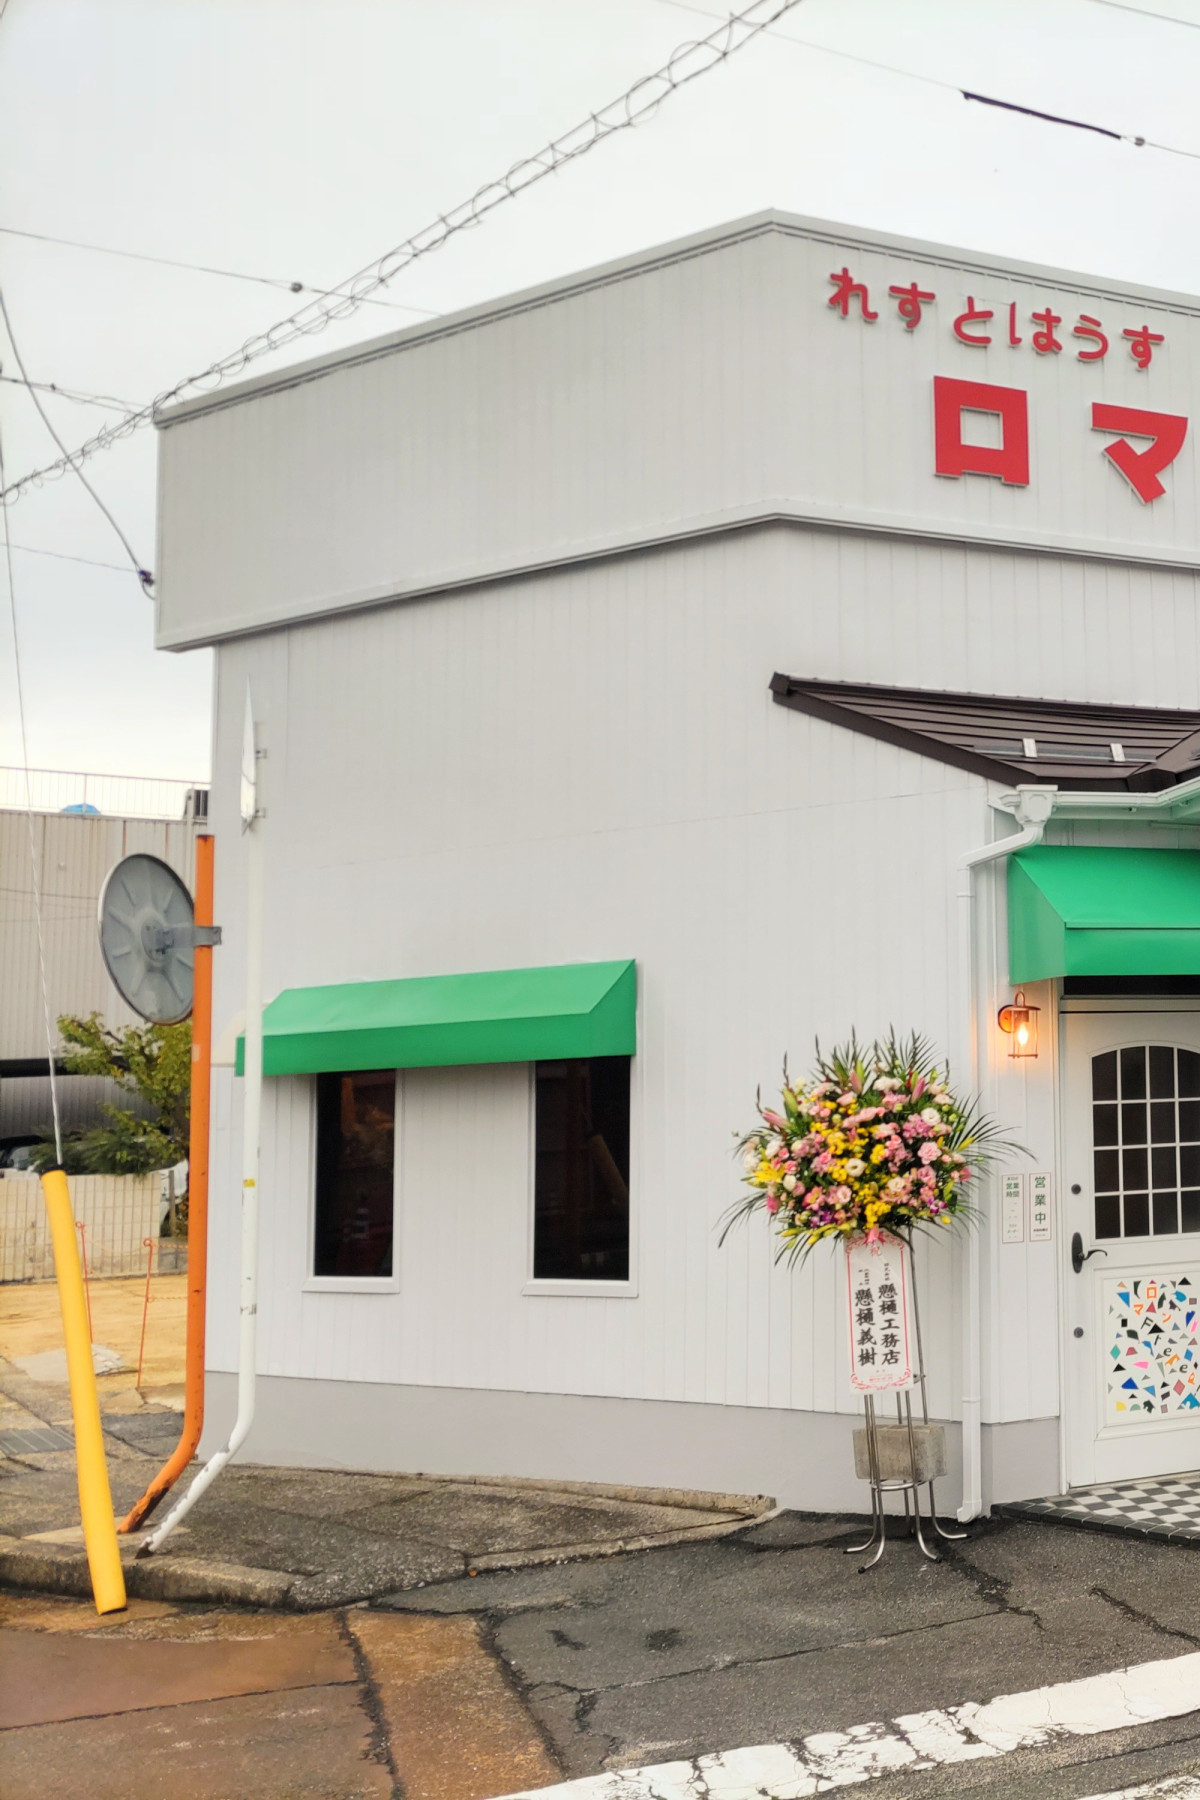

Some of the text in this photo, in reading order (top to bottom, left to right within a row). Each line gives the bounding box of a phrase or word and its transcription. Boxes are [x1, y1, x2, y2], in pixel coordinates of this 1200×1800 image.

[828, 267, 1165, 370] れすとはうす
[1034, 1176, 1046, 1224] 営業中
